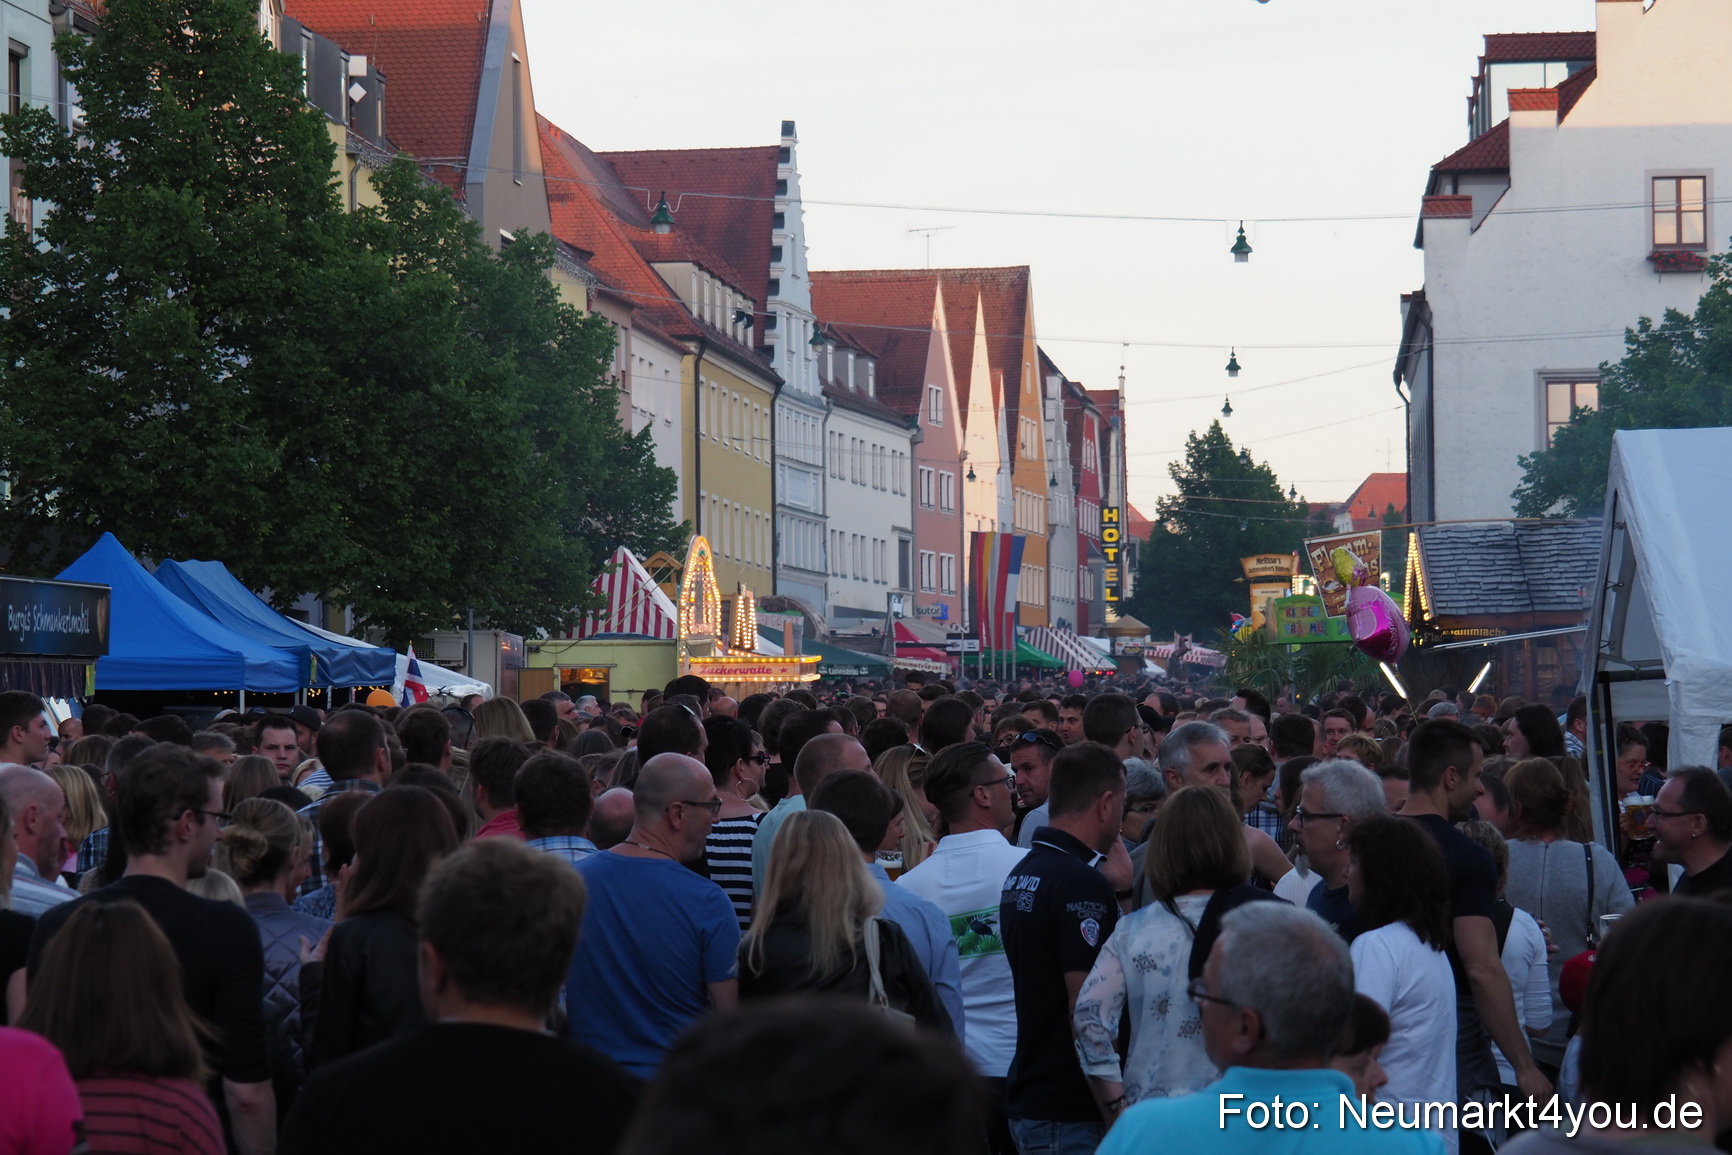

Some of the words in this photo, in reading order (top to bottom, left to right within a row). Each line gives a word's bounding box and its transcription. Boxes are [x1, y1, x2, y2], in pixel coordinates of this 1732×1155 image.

[1103, 508, 1119, 602] HOTEL
[916, 607, 941, 616] sutor
[8, 603, 31, 643] Burgi's
[699, 665, 773, 675] Zuckerwatte
[1016, 875, 1041, 892] DAVID
